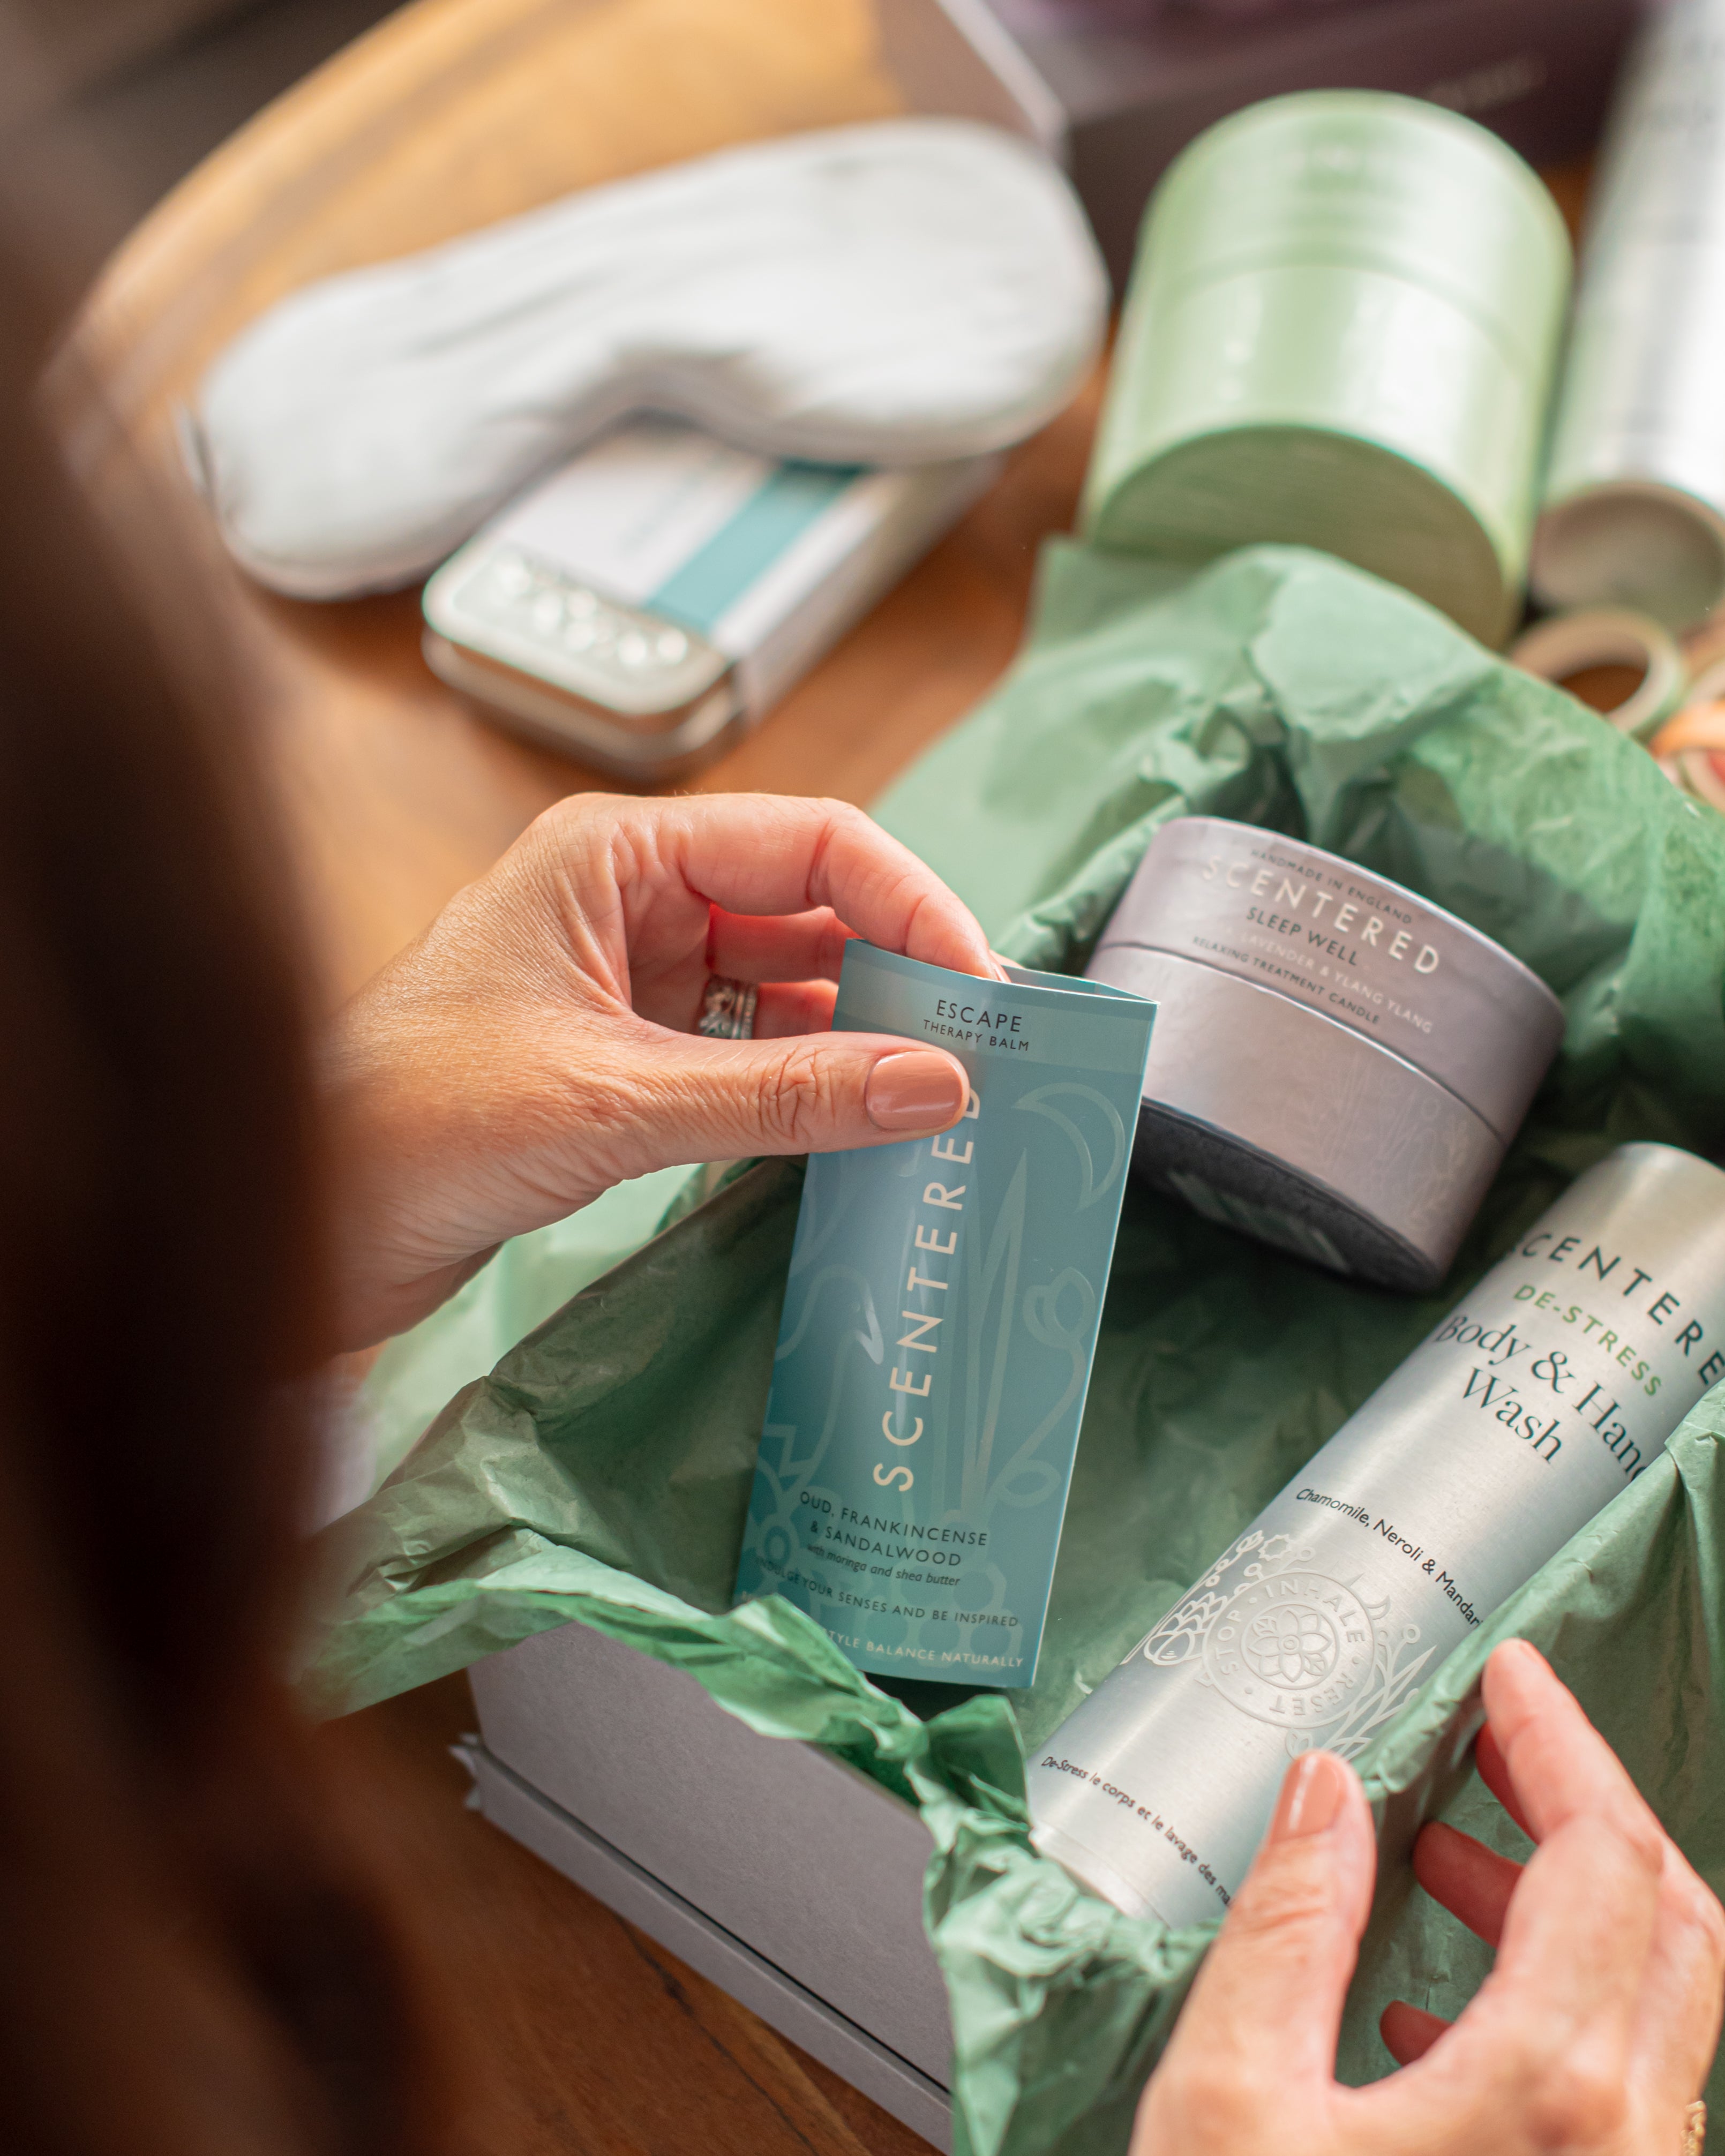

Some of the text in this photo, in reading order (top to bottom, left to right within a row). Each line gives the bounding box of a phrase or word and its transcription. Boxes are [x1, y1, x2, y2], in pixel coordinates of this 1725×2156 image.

[1203, 854, 1439, 974] SCENTERED
[1251, 849, 1412, 924] HANDMADE IN ENGLAND
[1246, 907, 1302, 936] SLEEP
[1308, 930, 1358, 966] WELL
[1192, 936, 1381, 1024] RELAXING TREATMENT CANDLE
[1334, 972, 1384, 1005] YLANG
[1387, 998, 1434, 1034] YLANG
[923, 1019, 1029, 1051] THERAPY BALM
[936, 1000, 1023, 1033] ESCAPE
[1512, 1234, 1725, 1386] CENTERE
[1513, 1284, 1662, 1396] DE-STRESS
[1433, 1316, 1532, 1366] Body
[1530, 1350, 1577, 1394] &
[1462, 1365, 1563, 1465] Wash
[800, 1491, 988, 1546] OUD, FRANKINCENSE
[810, 1520, 962, 1566] & SANDALWOOD
[1295, 1488, 1370, 1527] Chamomile,
[1372, 1518, 1424, 1562] Neroli
[1421, 1559, 1436, 1575] &
[807, 1543, 961, 1587] with moringa and shea butter
[803, 1577, 833, 1598] YOUR
[838, 1591, 887, 1612] SENSES
[892, 1605, 925, 1618] AND
[932, 1610, 948, 1621] BE
[954, 1612, 1018, 1627] INSPIRED
[1264, 1579, 1366, 1643] INHALE
[823, 1627, 1024, 1667] TYLE BALANCE NATURALLY
[1214, 1609, 1243, 1676] STOP
[1269, 1671, 1355, 1716] RESET
[1041, 1756, 1233, 1907] De-Stress le corps et le lavage des ma
